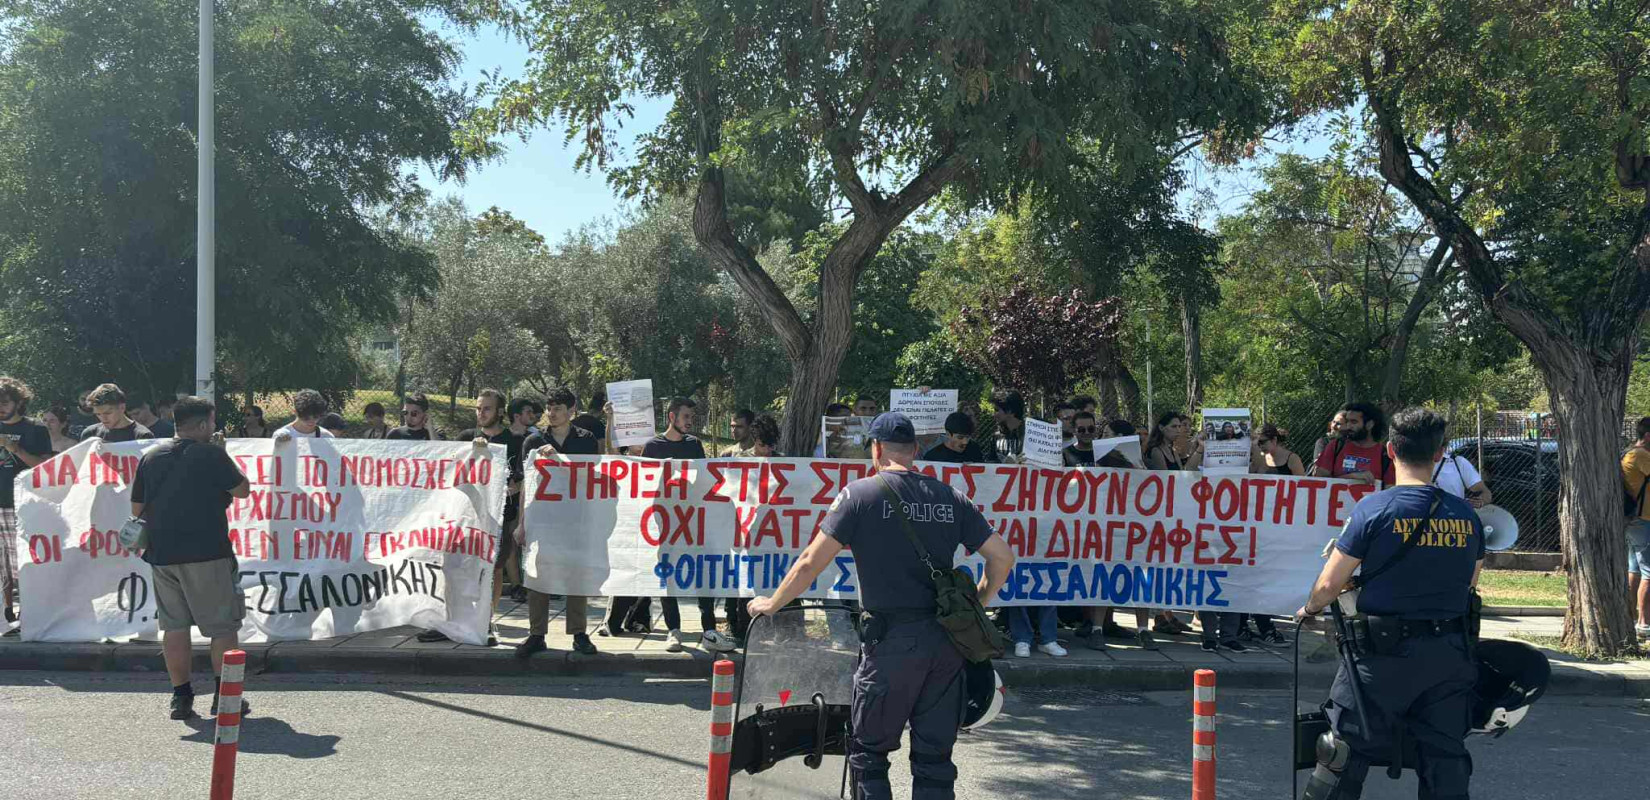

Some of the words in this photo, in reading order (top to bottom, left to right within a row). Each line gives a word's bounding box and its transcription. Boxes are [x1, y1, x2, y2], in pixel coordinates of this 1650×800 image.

[32, 454, 79, 489] ΝΑ
[339, 455, 492, 490] ΝΟΜΟΣΧΕΔΙΟ
[533, 458, 689, 501] ΣΤΗΡΙΞΗ
[703, 461, 796, 506] ΣΤΙΣ
[992, 465, 1130, 516] ΖΗΤΟΥΝ
[1135, 473, 1176, 518] ΟΙ
[28, 534, 62, 565] ΟΙ
[293, 527, 353, 563] ΕΙΝΑΙ
[639, 503, 706, 547] ΟΧΙ
[1043, 518, 1258, 566] ΔΙΑΓΡΑΦΕΣ!
